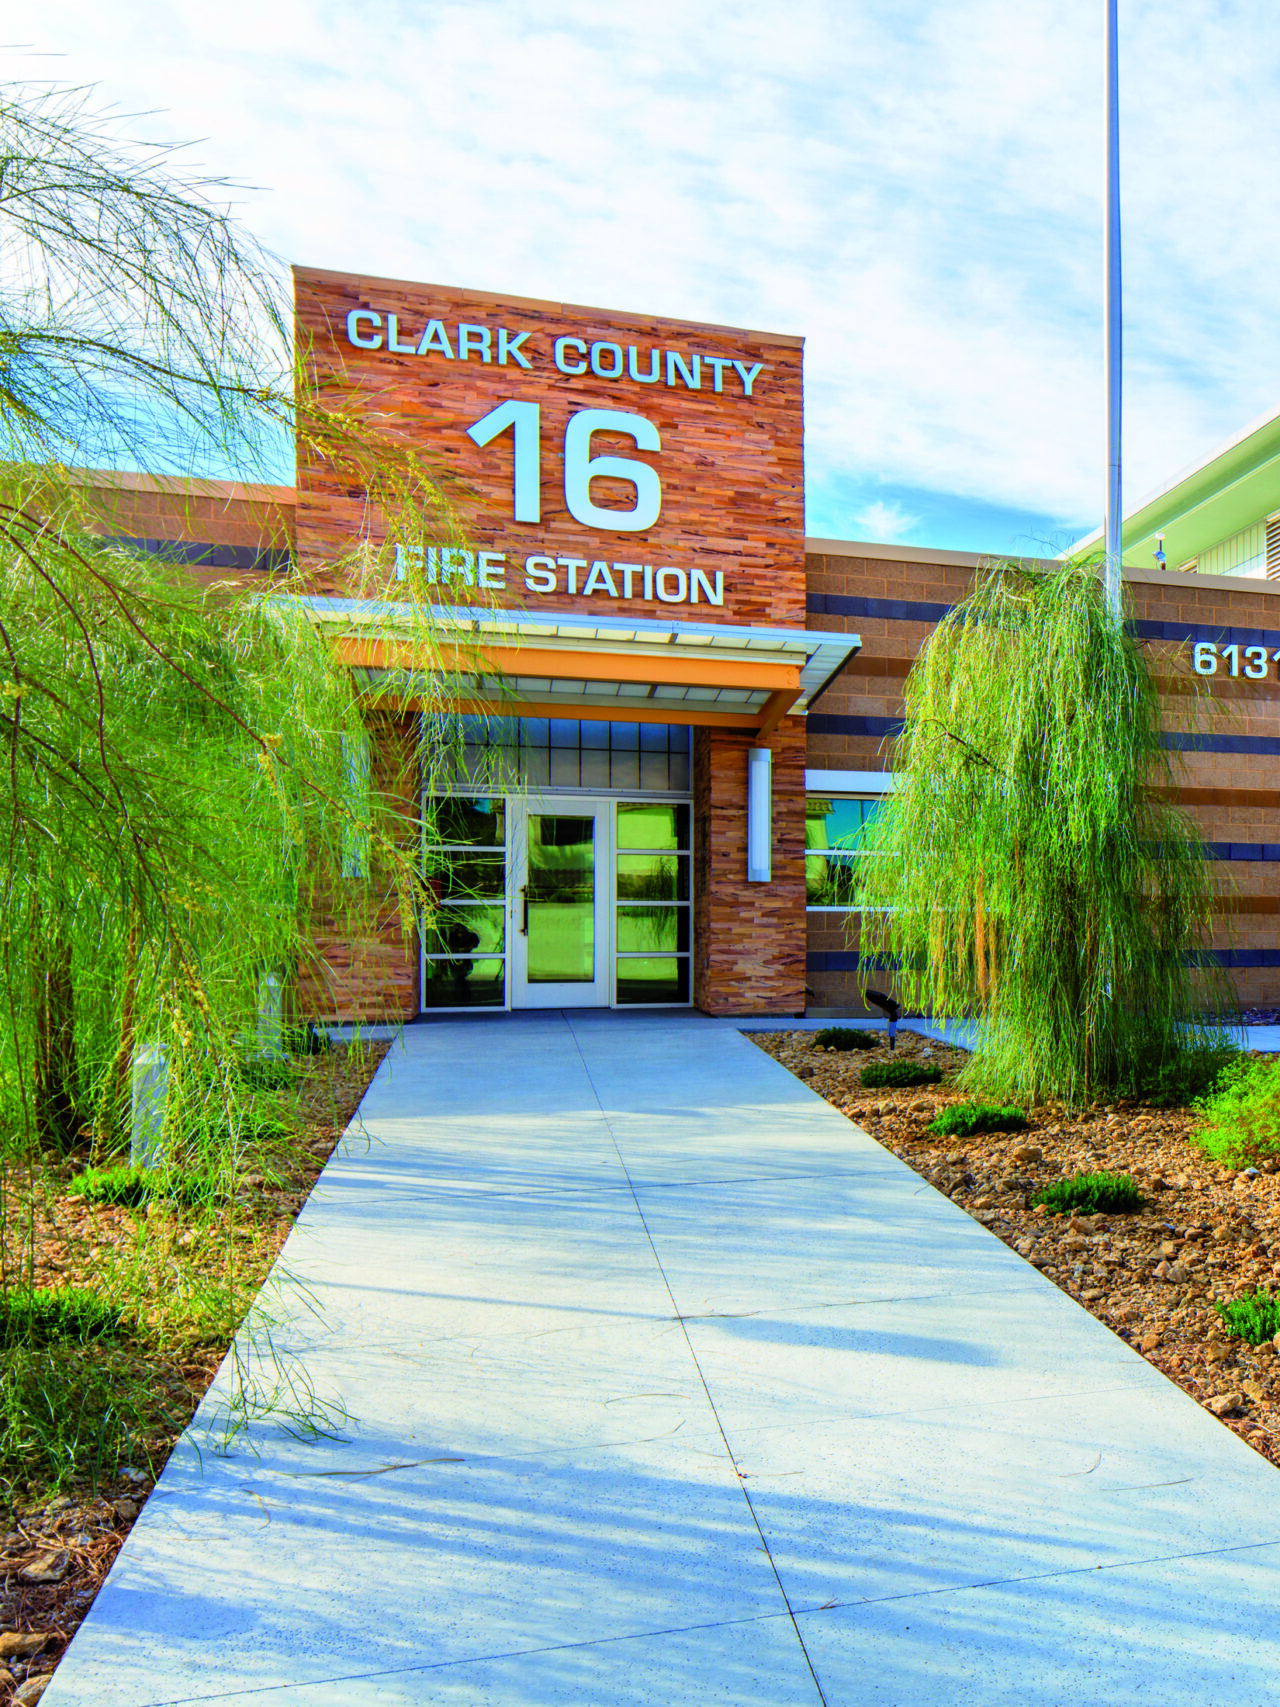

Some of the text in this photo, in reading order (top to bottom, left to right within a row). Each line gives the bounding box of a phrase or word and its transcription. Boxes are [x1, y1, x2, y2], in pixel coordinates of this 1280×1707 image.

[346, 309, 764, 396] CLARK COUNTY
[465, 399, 663, 532] 16
[394, 543, 724, 606] FIRE STATION
